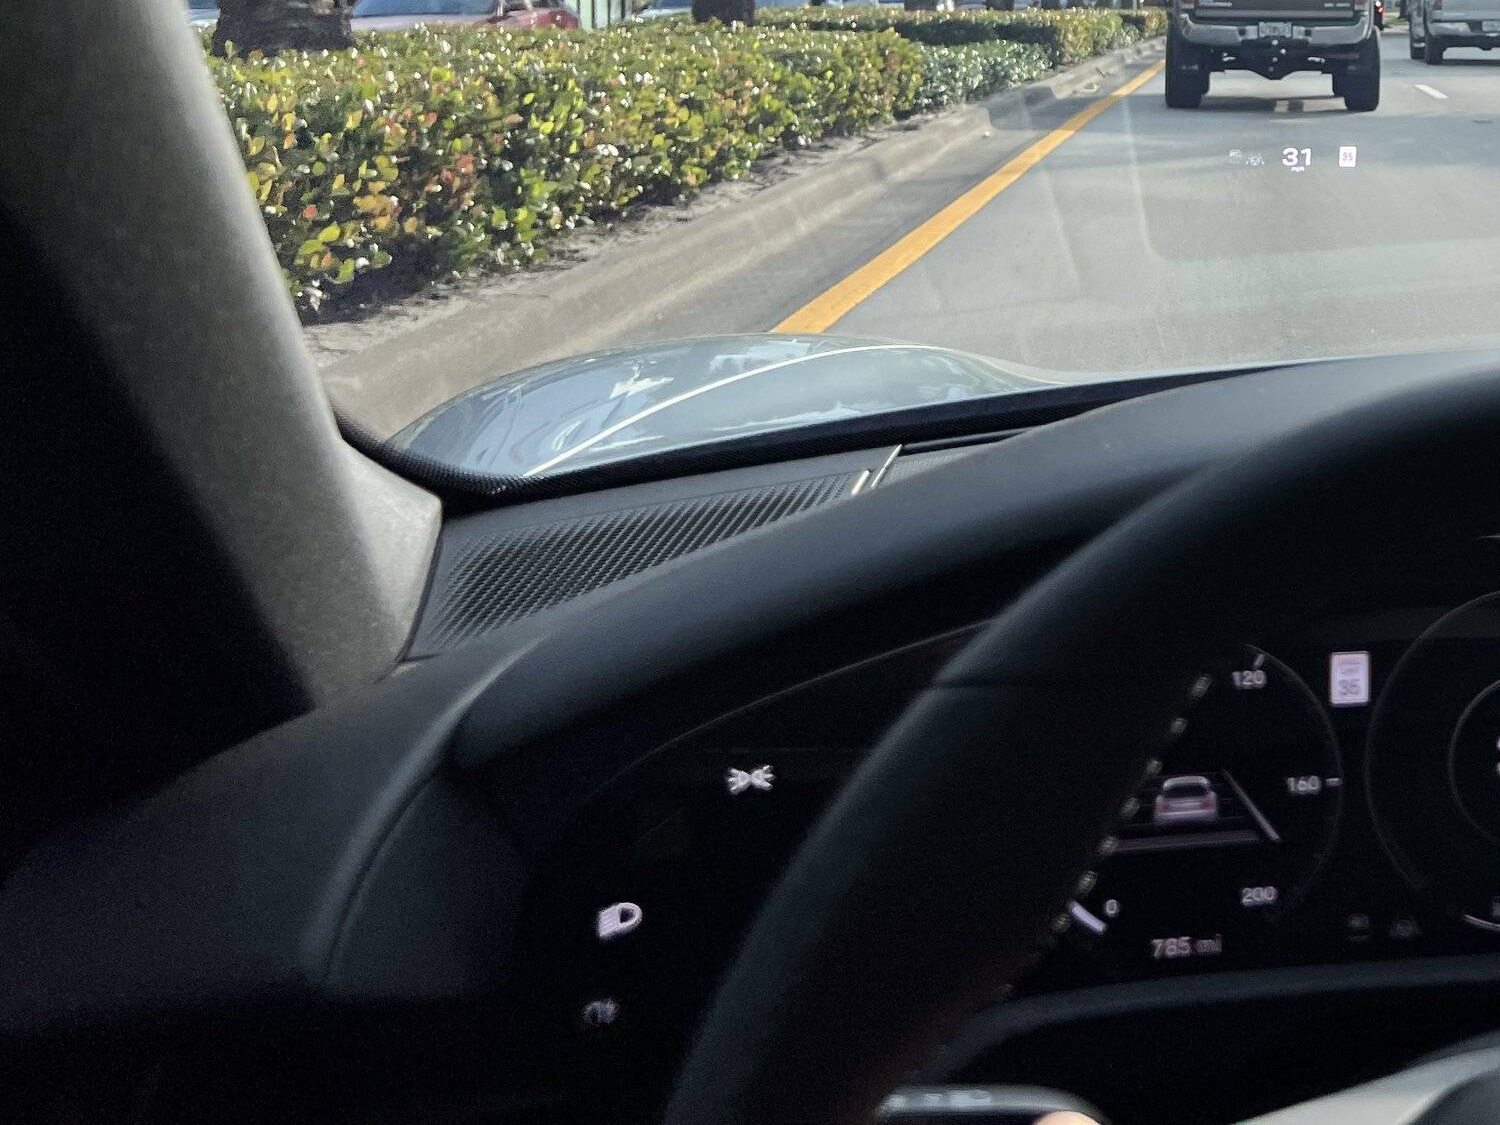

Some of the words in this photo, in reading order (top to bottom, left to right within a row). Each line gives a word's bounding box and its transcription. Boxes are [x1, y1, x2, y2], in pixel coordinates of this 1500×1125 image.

[1282, 147, 1311, 166] 31
[1232, 670, 1266, 690] 120
[1286, 775, 1321, 795] 160
[1240, 885, 1277, 907] 200
